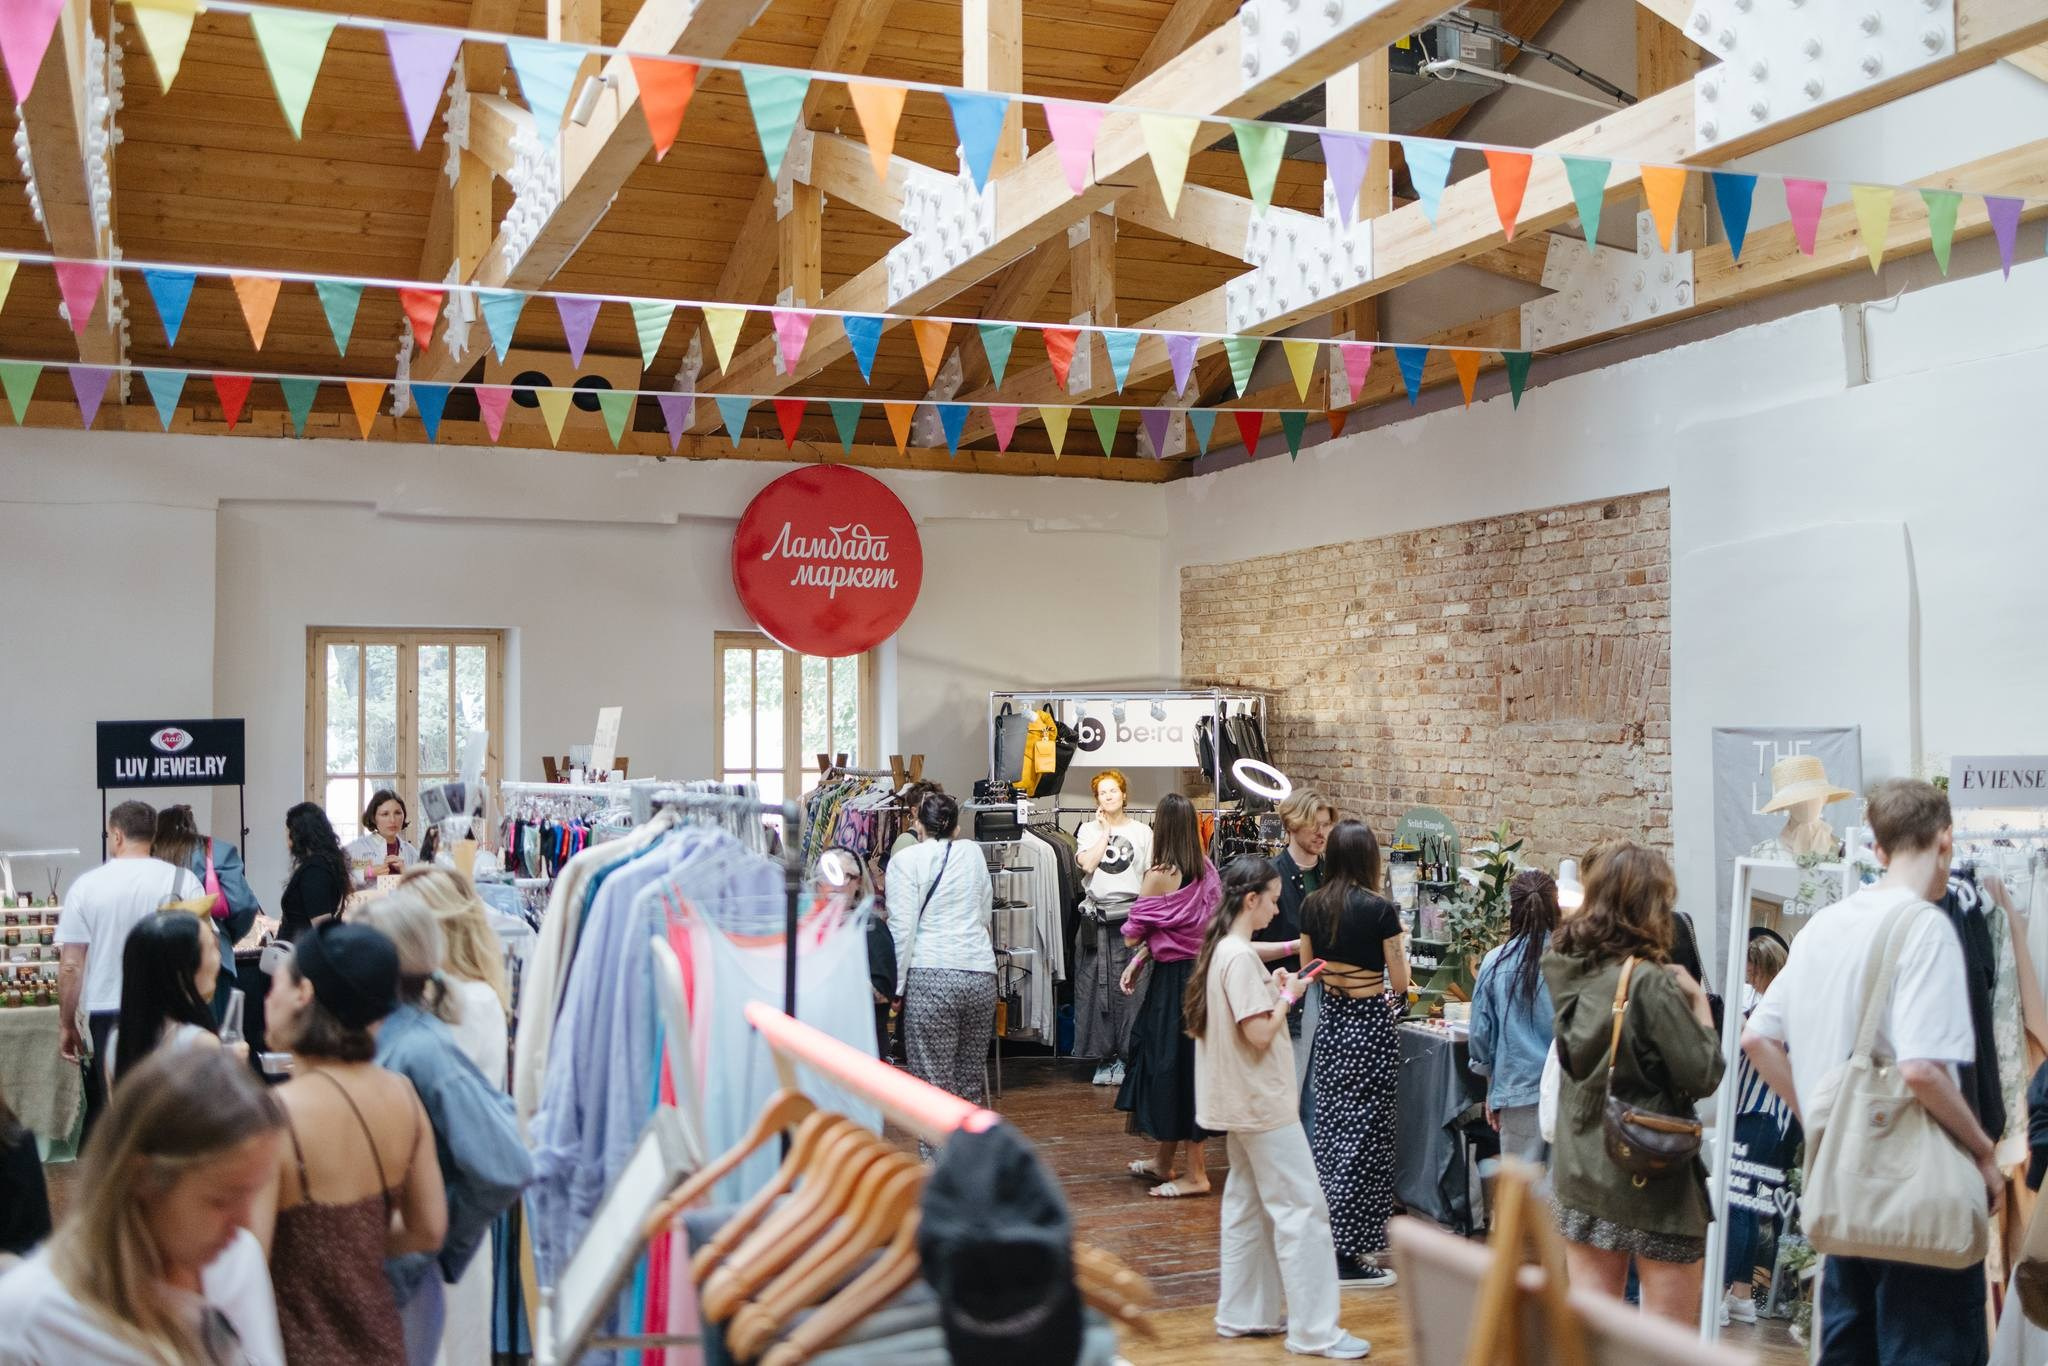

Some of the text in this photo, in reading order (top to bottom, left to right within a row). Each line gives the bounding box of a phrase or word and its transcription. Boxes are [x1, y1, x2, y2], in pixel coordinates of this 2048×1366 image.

[762, 521, 889, 561] Ламбада
[790, 564, 898, 599] маркет
[1116, 720, 1183, 743] be:ra
[116, 756, 226, 778] LUV JEWELRY
